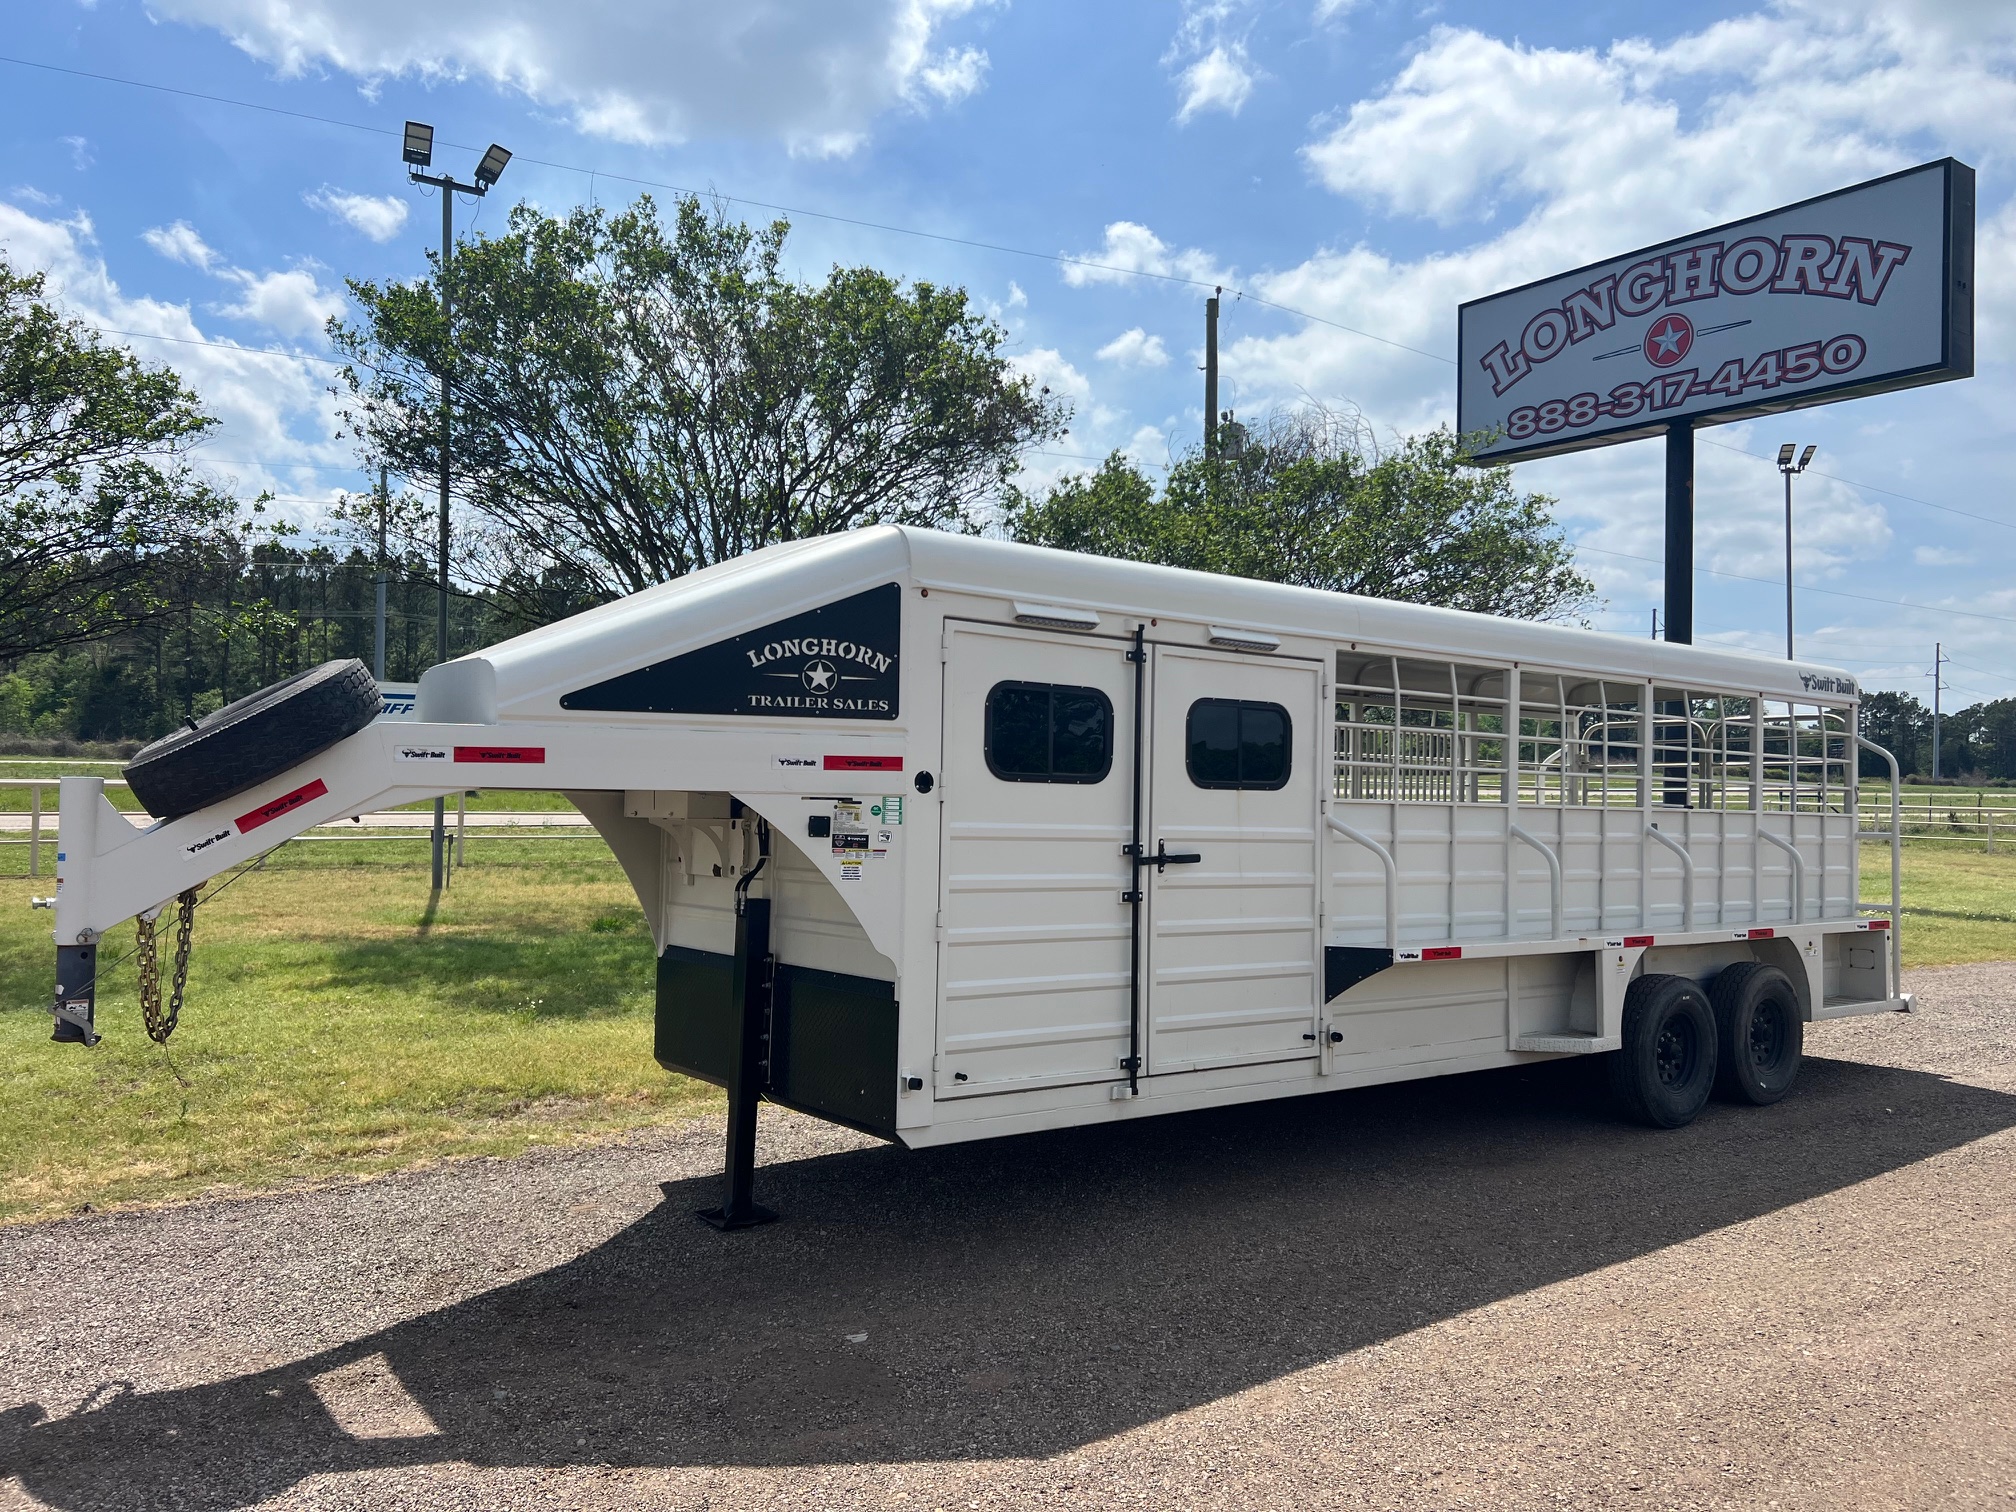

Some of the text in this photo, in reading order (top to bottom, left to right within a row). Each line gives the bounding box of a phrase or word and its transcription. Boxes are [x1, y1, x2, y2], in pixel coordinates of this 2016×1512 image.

[1480, 233, 1913, 398] LONGHORN
[1506, 333, 1867, 441] 888-317-4450
[746, 637, 892, 674] LONGHORN
[1811, 674, 1855, 695] Swift Built
[747, 695, 889, 712] TRAILER SALES
[410, 750, 446, 759] Swift Built
[195, 829, 231, 850] Swift Built
